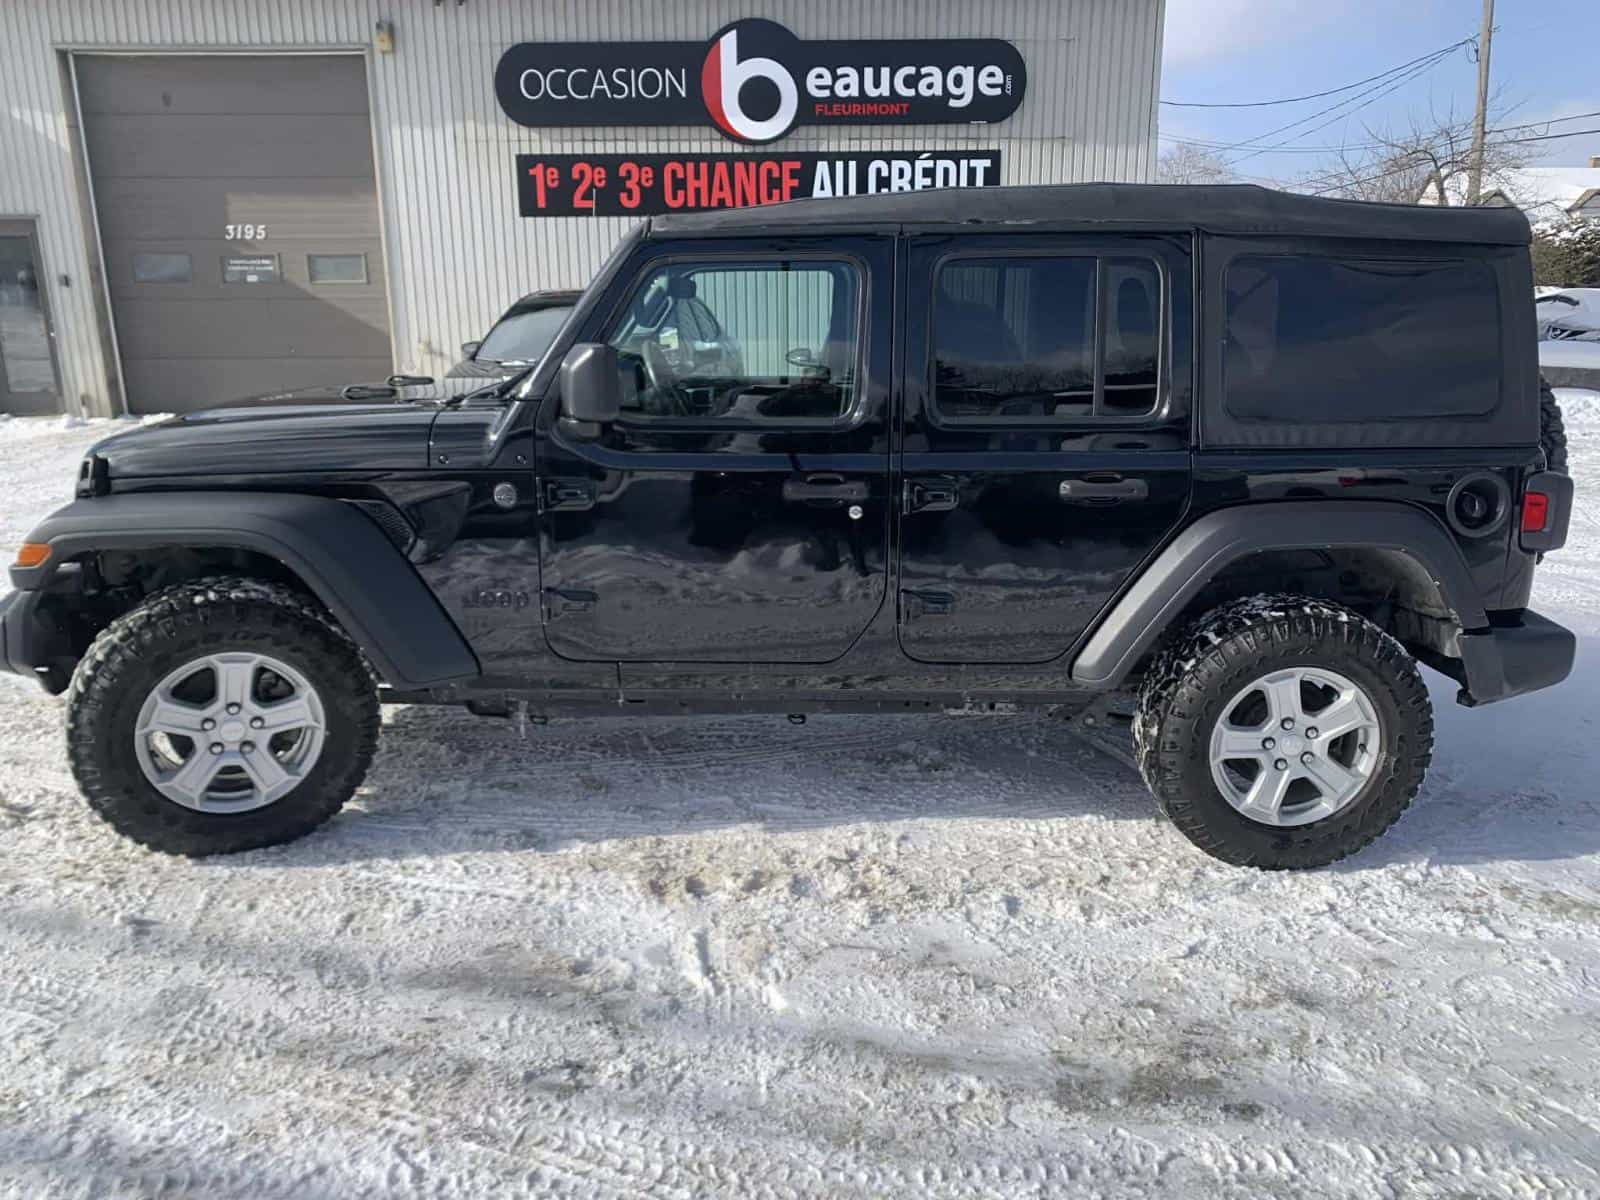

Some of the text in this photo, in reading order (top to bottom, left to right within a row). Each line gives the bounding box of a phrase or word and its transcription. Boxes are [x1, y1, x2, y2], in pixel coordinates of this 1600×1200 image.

[519, 67, 688, 101] OCCASION
[814, 103, 910, 117] FLEURIMONT
[663, 160, 802, 208] CHANCE
[225, 224, 266, 240] 3195
